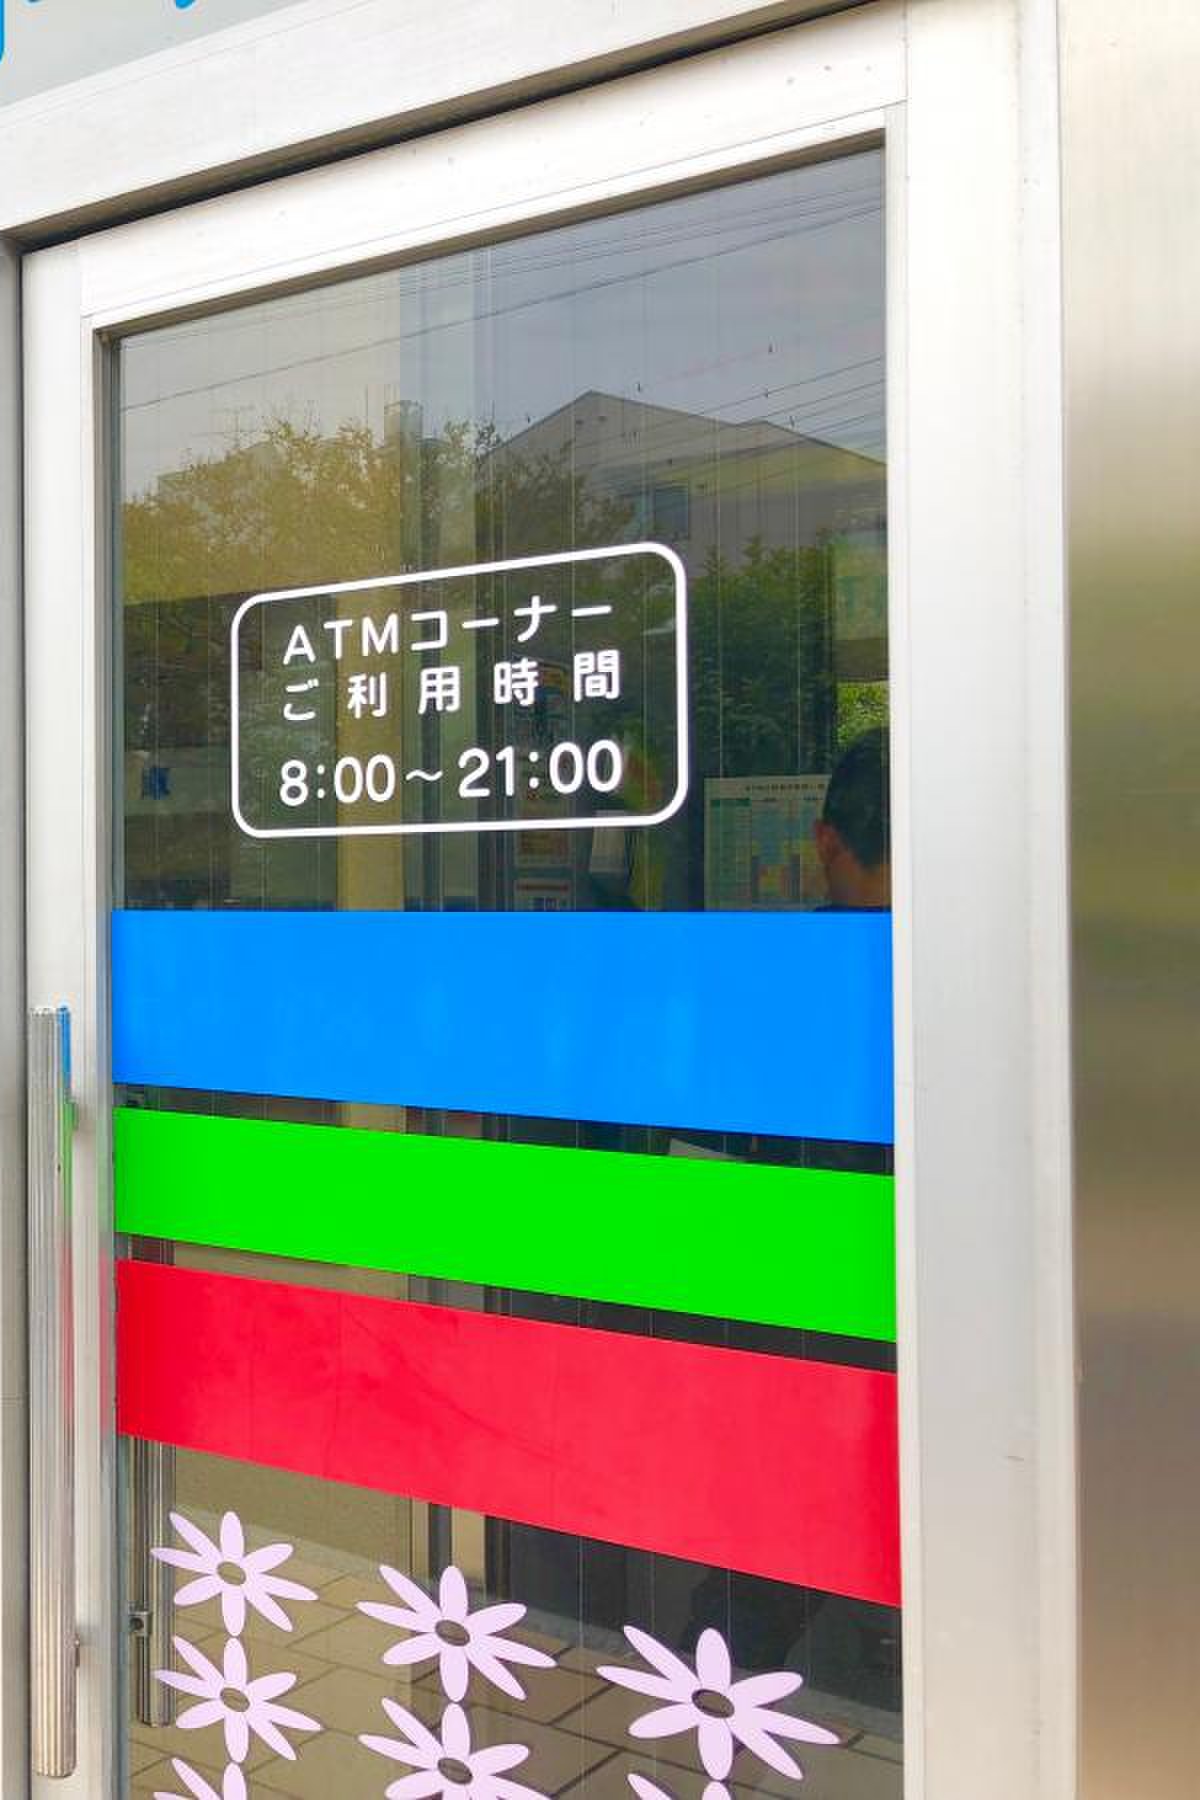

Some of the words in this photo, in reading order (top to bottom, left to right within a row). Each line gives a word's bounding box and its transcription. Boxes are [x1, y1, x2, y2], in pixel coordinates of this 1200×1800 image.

[282, 595, 613, 666] ATMコーナー
[283, 648, 621, 721] ご利用時間
